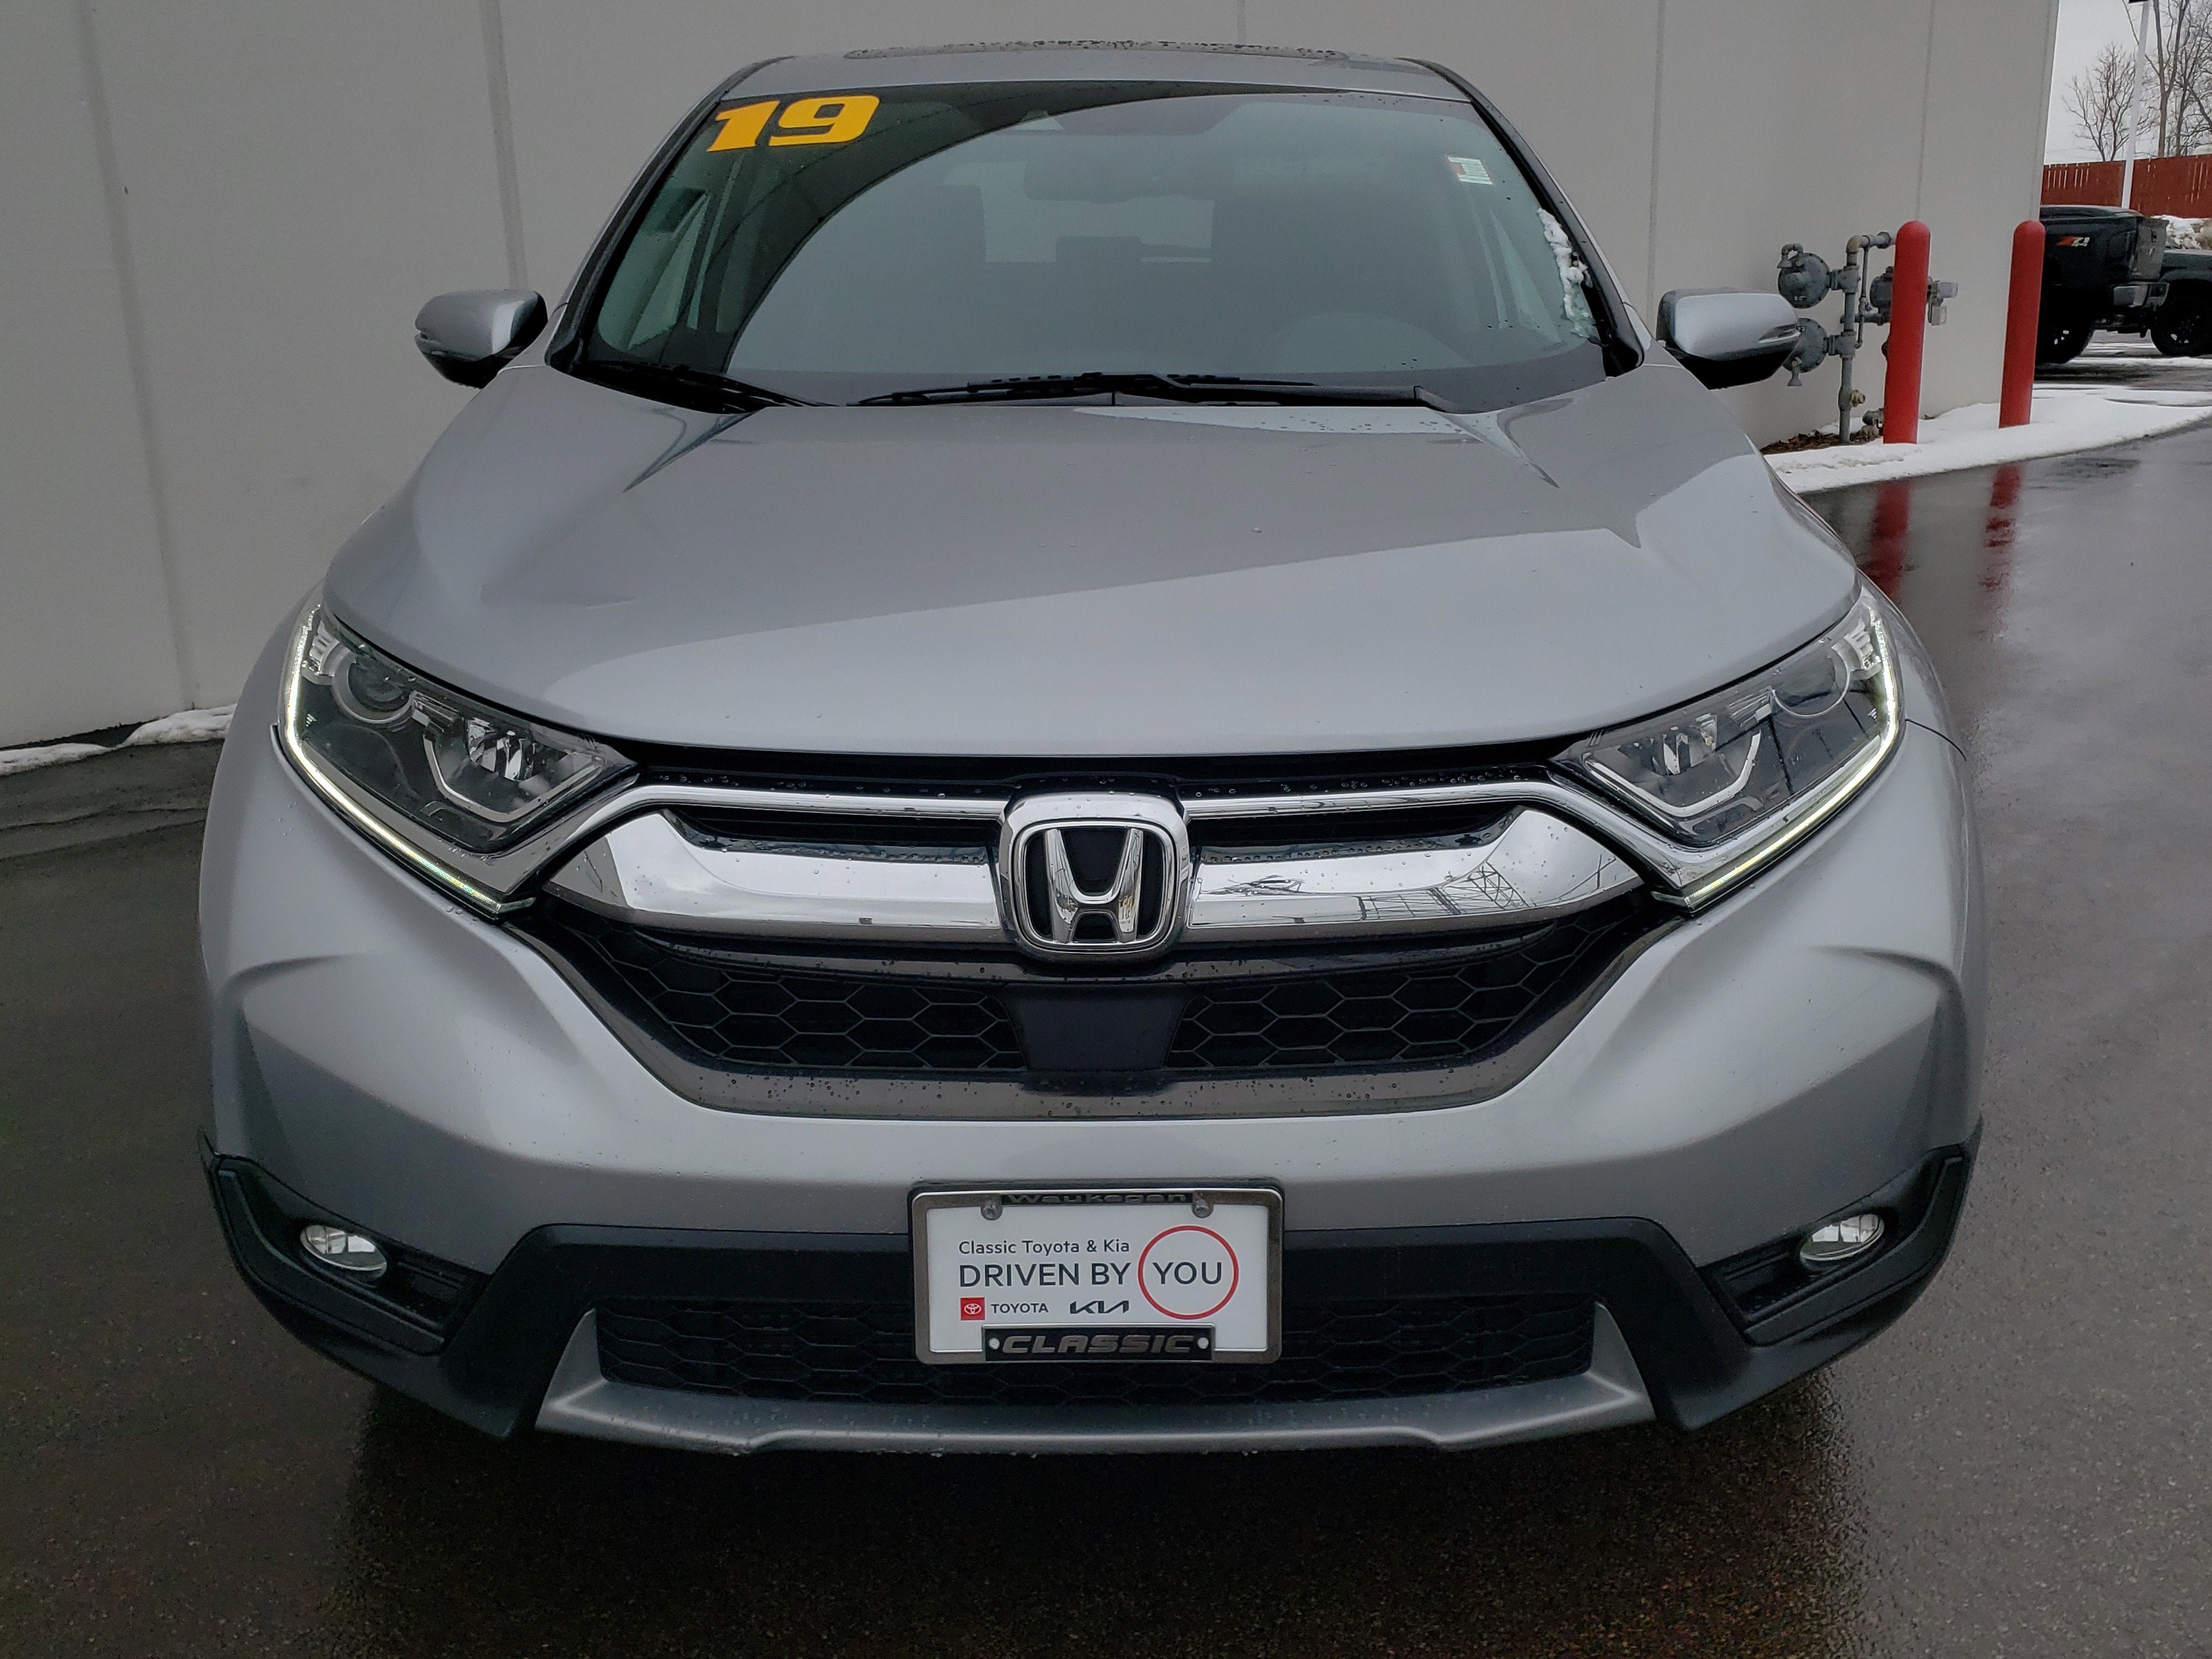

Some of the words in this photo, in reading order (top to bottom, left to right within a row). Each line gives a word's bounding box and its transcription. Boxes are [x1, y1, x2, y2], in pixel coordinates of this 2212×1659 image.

[706, 95, 880, 152] 19
[959, 1240, 1017, 1254] Classic
[1022, 1240, 1080, 1256] Toyota
[1086, 1239, 1097, 1252] &
[1104, 1239, 1130, 1252] Kia
[960, 1263, 1080, 1287] DRIVEN
[1091, 1262, 1132, 1285] BY
[1153, 1261, 1222, 1285] YOU
[991, 1302, 1049, 1313] TOYOTA
[1002, 1335, 1194, 1354] CLASSIC
